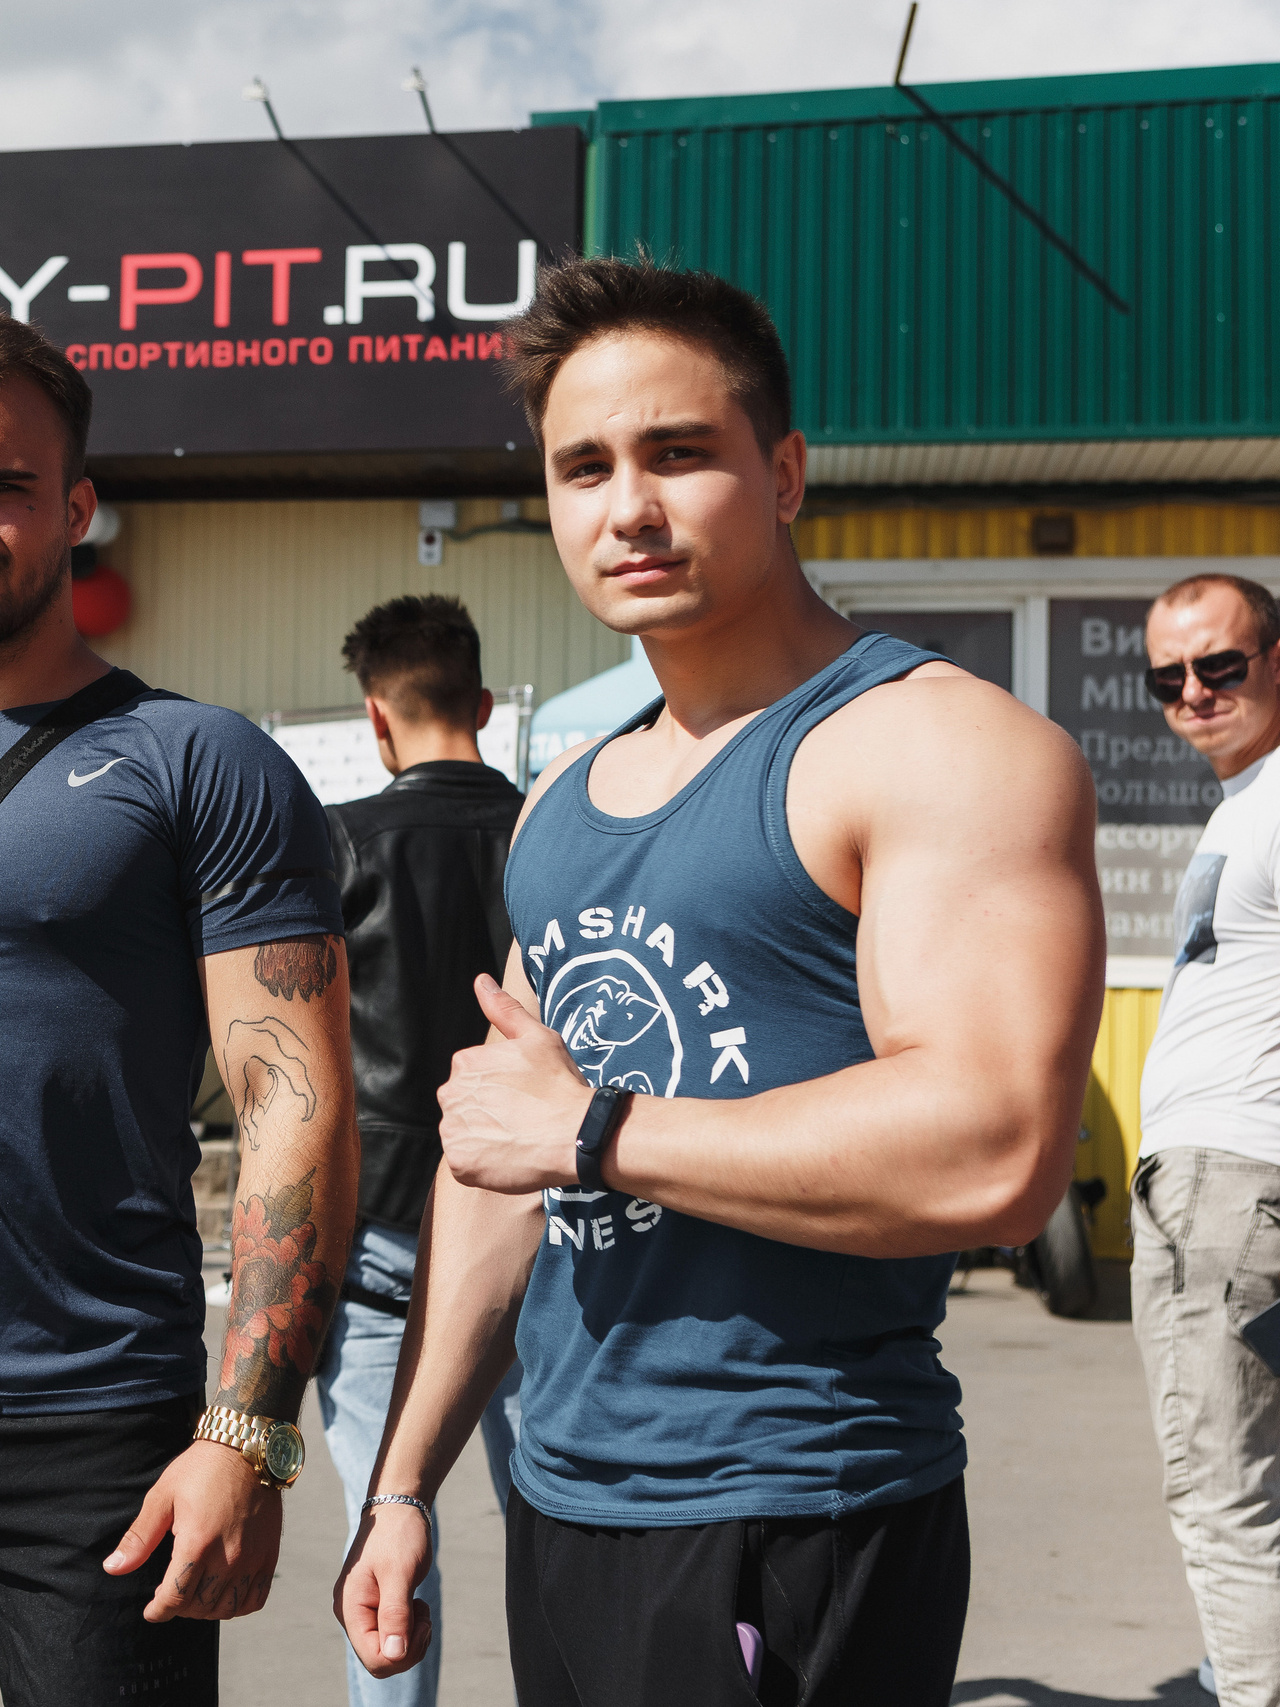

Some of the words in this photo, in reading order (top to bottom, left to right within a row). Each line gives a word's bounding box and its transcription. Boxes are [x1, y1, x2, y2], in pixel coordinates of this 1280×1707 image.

[66, 333, 334, 371] СПОРТИВНОГО
[1081, 617, 1145, 658] Ви
[1081, 729, 1210, 769] Предл
[1093, 770, 1223, 807] ольшо
[1098, 826, 1205, 858] ссорт
[528, 905, 749, 1085] MSHARK
[548, 1197, 663, 1251] NES
